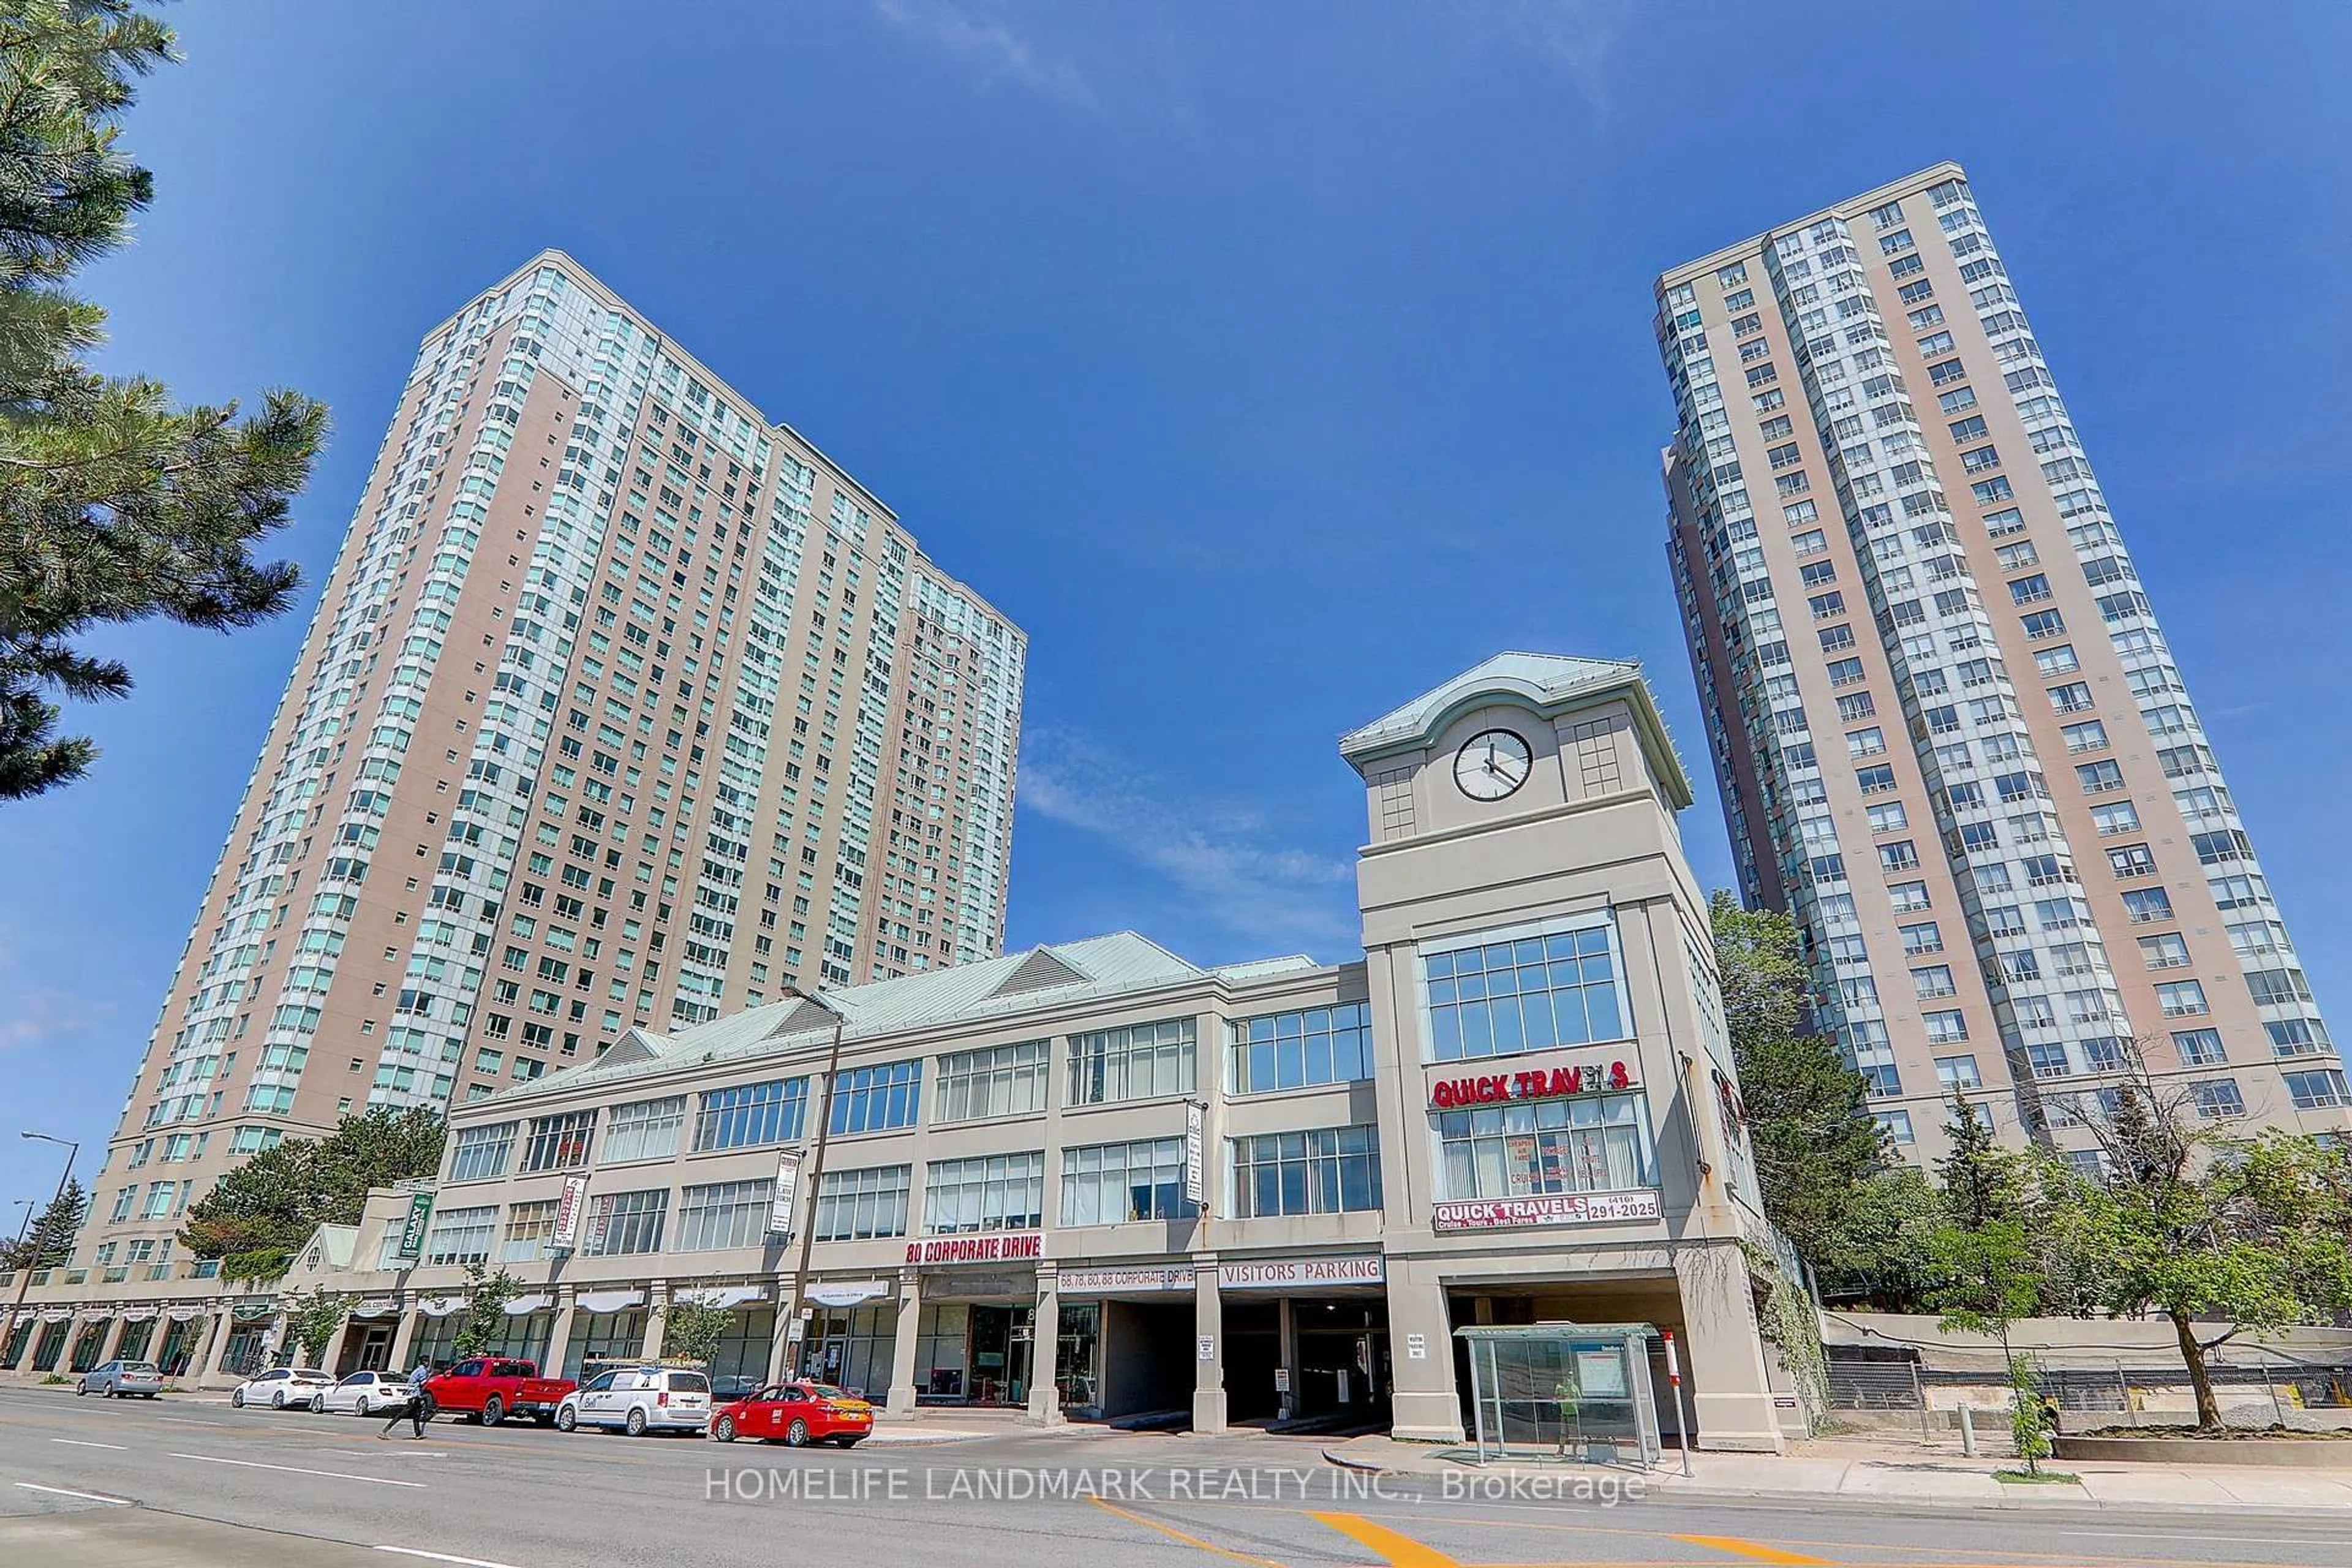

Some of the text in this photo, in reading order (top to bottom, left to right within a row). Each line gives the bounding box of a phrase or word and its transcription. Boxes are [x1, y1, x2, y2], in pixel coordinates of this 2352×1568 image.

[1433, 1074, 1510, 1108] QUICK
[1439, 1202, 1496, 1221] QUICK
[1501, 1197, 1588, 1218] TRAVELS
[1591, 1203, 1656, 1218] 291-2025
[404, 1205, 421, 1248] GALAXY
[906, 1235, 1041, 1262] 80 CORPORATE DRIVE
[1115, 1270, 1164, 1284] CORPORATE
[1168, 1269, 1193, 1283] DRIVE
[1225, 1261, 1378, 1282] VISITORS PARKING
